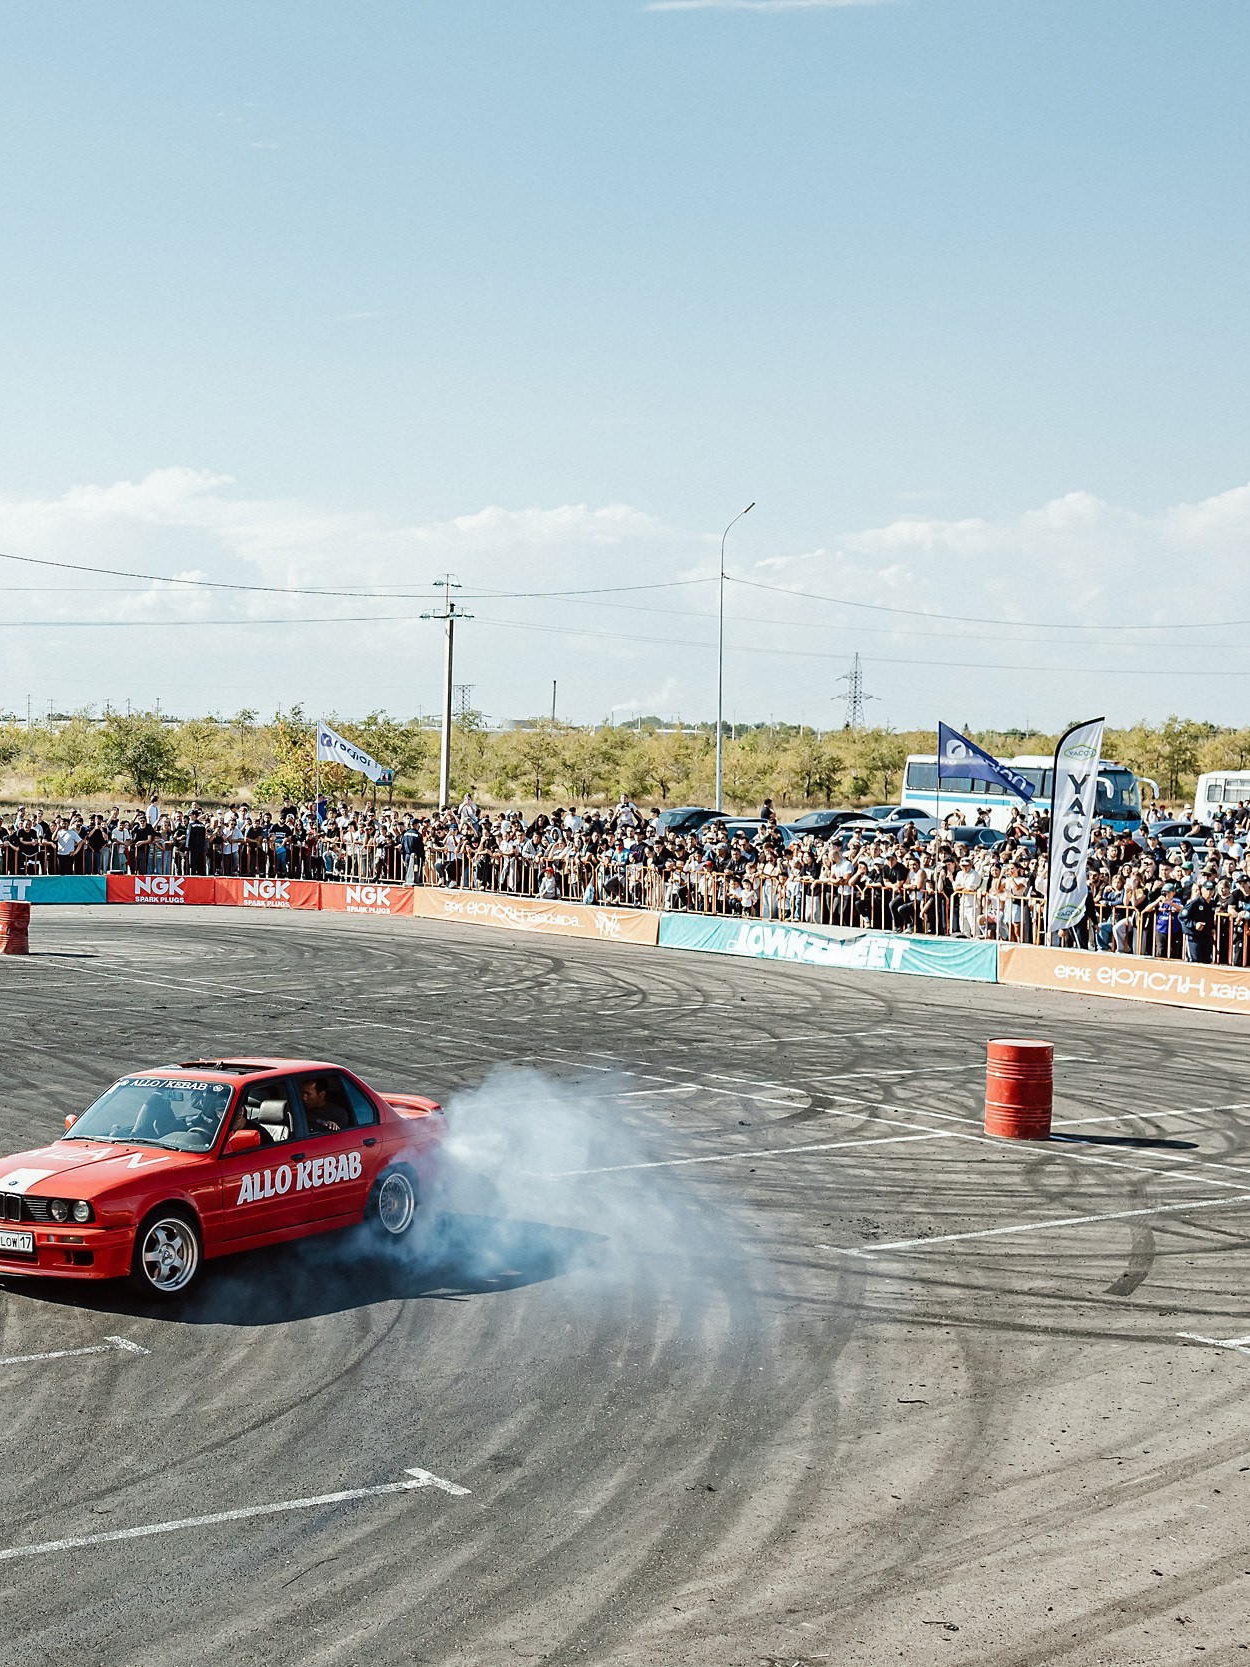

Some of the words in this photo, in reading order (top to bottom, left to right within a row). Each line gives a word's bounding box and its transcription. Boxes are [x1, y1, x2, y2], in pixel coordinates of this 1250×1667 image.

[1060, 774, 1091, 893] YACCO
[134, 876, 185, 896] NGK
[243, 879, 291, 900] NGK
[346, 885, 391, 907] NGK
[237, 1165, 292, 1205] ALLO
[296, 1151, 362, 1191] KEBAB
[20, 1236, 32, 1249] 17
